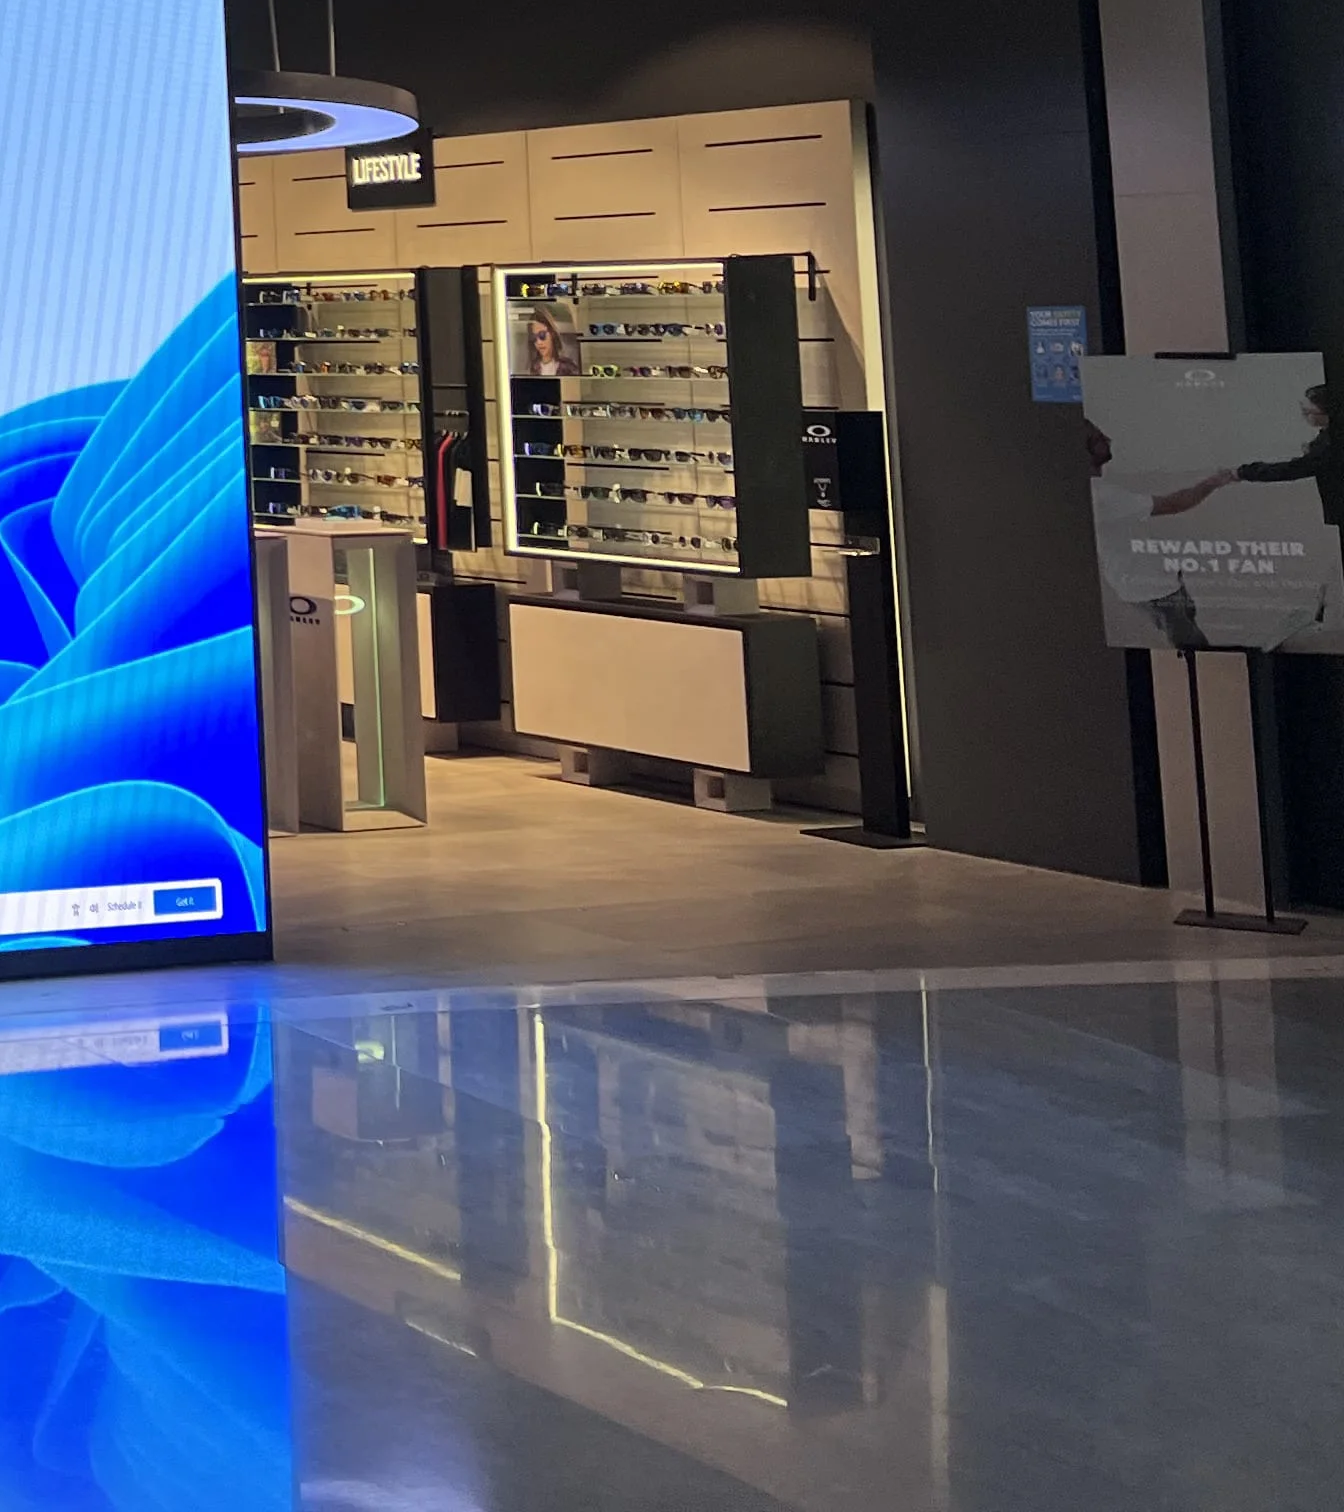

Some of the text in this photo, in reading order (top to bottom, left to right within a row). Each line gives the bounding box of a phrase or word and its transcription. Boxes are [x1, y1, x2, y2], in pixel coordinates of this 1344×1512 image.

[352, 152, 421, 186] LIFESTYLE
[1130, 539, 1306, 558] REWARD THEIR
[1164, 558, 1275, 575] NO.1 FAN
